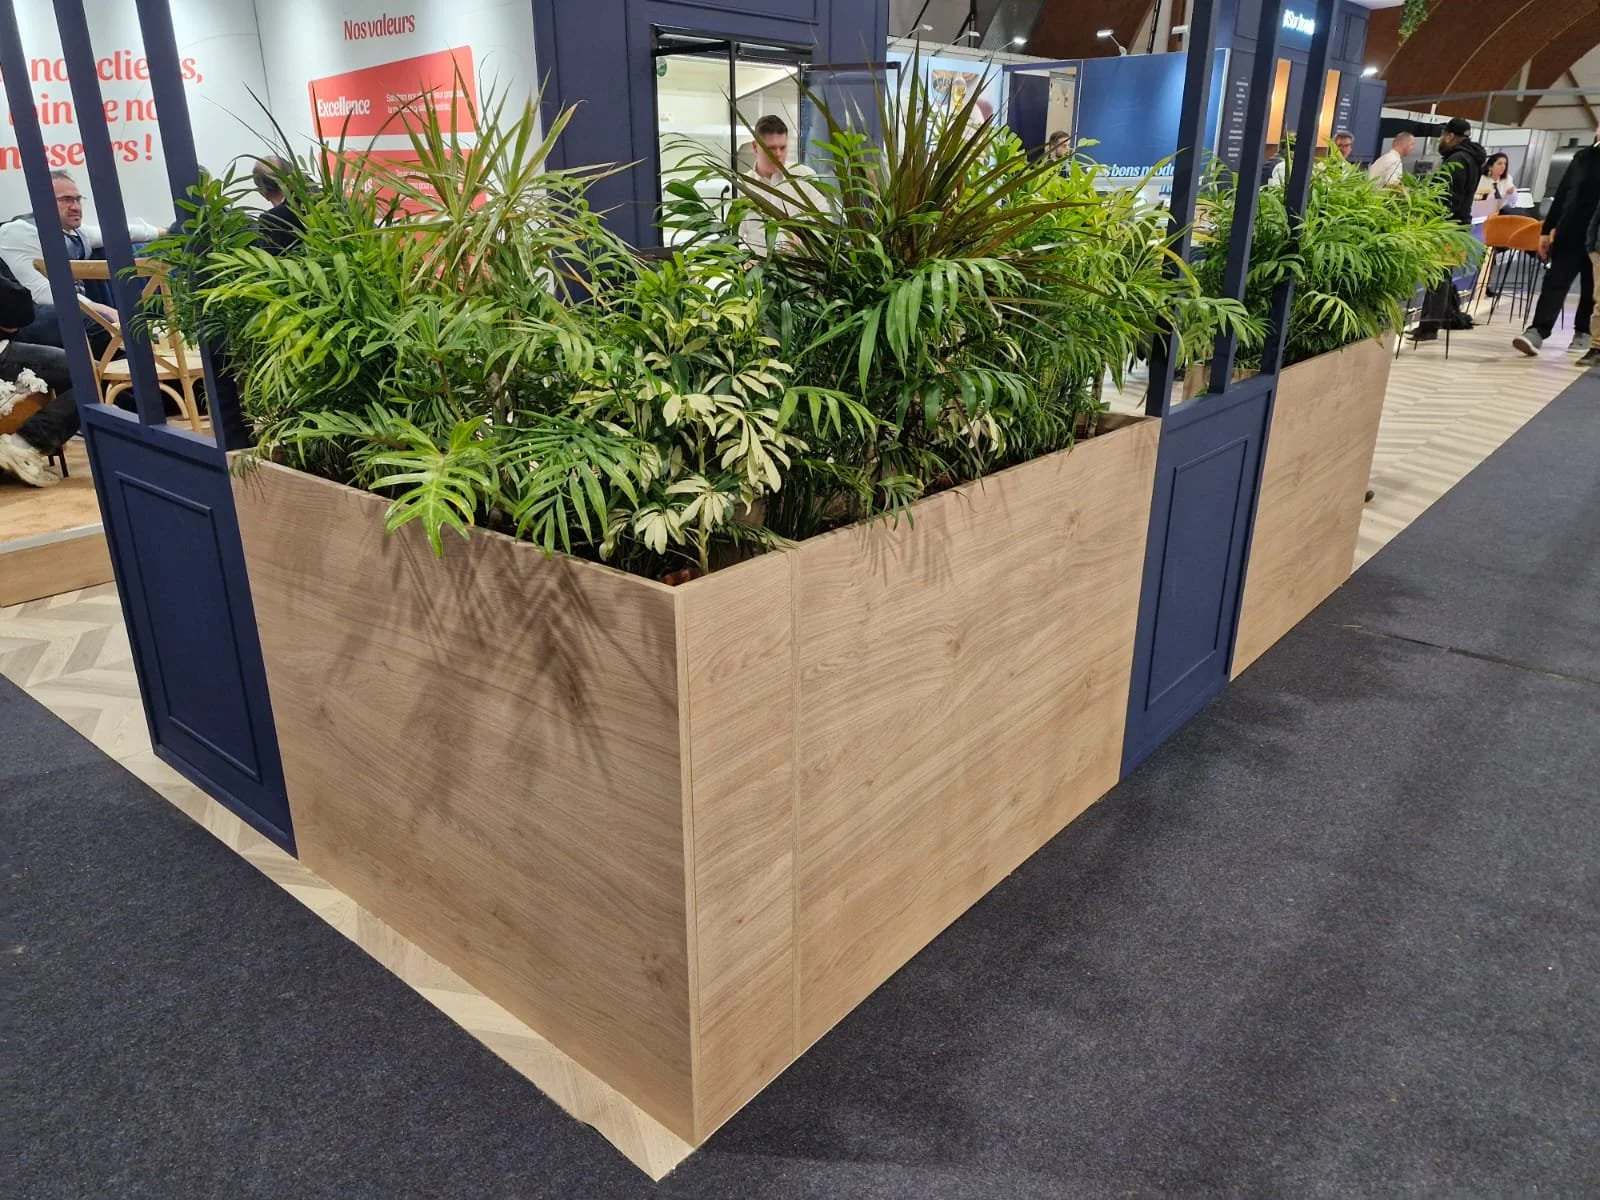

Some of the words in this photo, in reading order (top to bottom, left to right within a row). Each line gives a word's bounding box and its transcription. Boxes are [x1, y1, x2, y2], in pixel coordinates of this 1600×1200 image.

[344, 20, 367, 40] Nos
[367, 13, 415, 37] valeurs
[31, 57, 70, 82] no
[125, 98, 159, 121] no
[317, 96, 371, 117] Excellence
